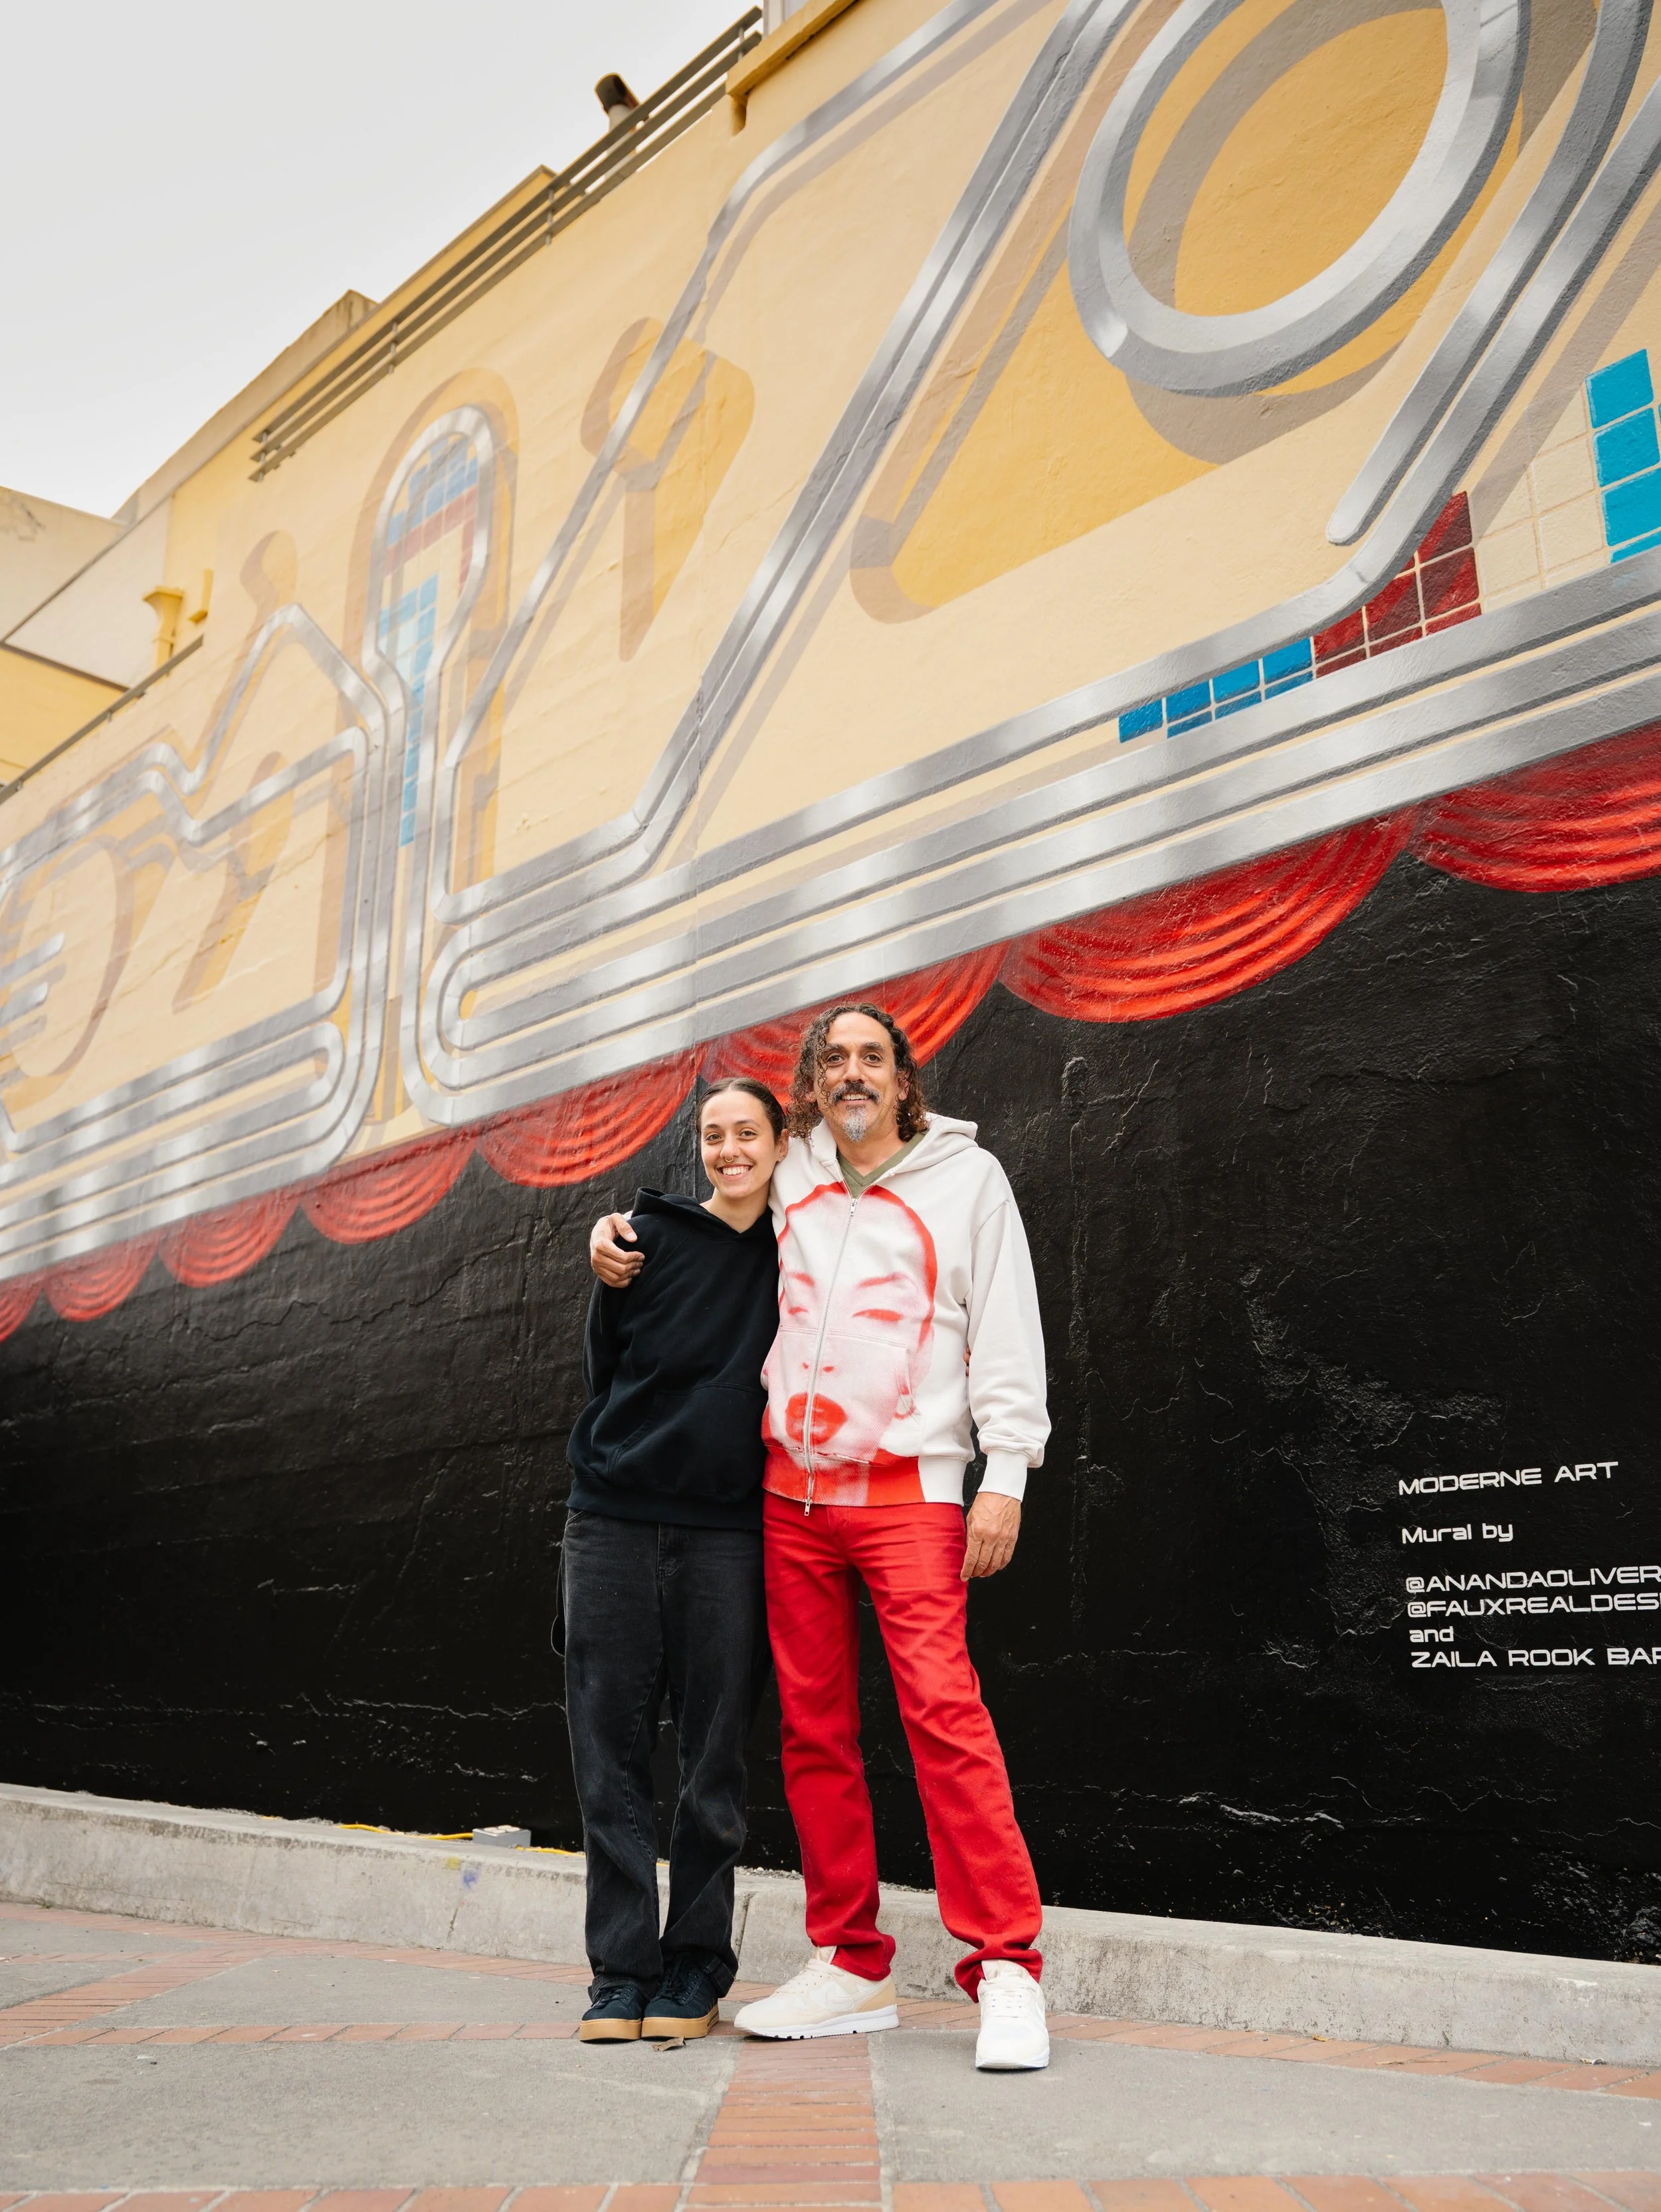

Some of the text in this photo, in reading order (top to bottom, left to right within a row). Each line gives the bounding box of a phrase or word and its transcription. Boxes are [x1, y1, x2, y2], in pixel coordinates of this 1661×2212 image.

[1399, 1461, 1618, 1495] MODERNE ART
[1402, 1522, 1514, 1544] Mural by
[1409, 1625, 1454, 1643] and
[1411, 1650, 1498, 1668] ZAILA
[1508, 1648, 1596, 1667] ROOK
